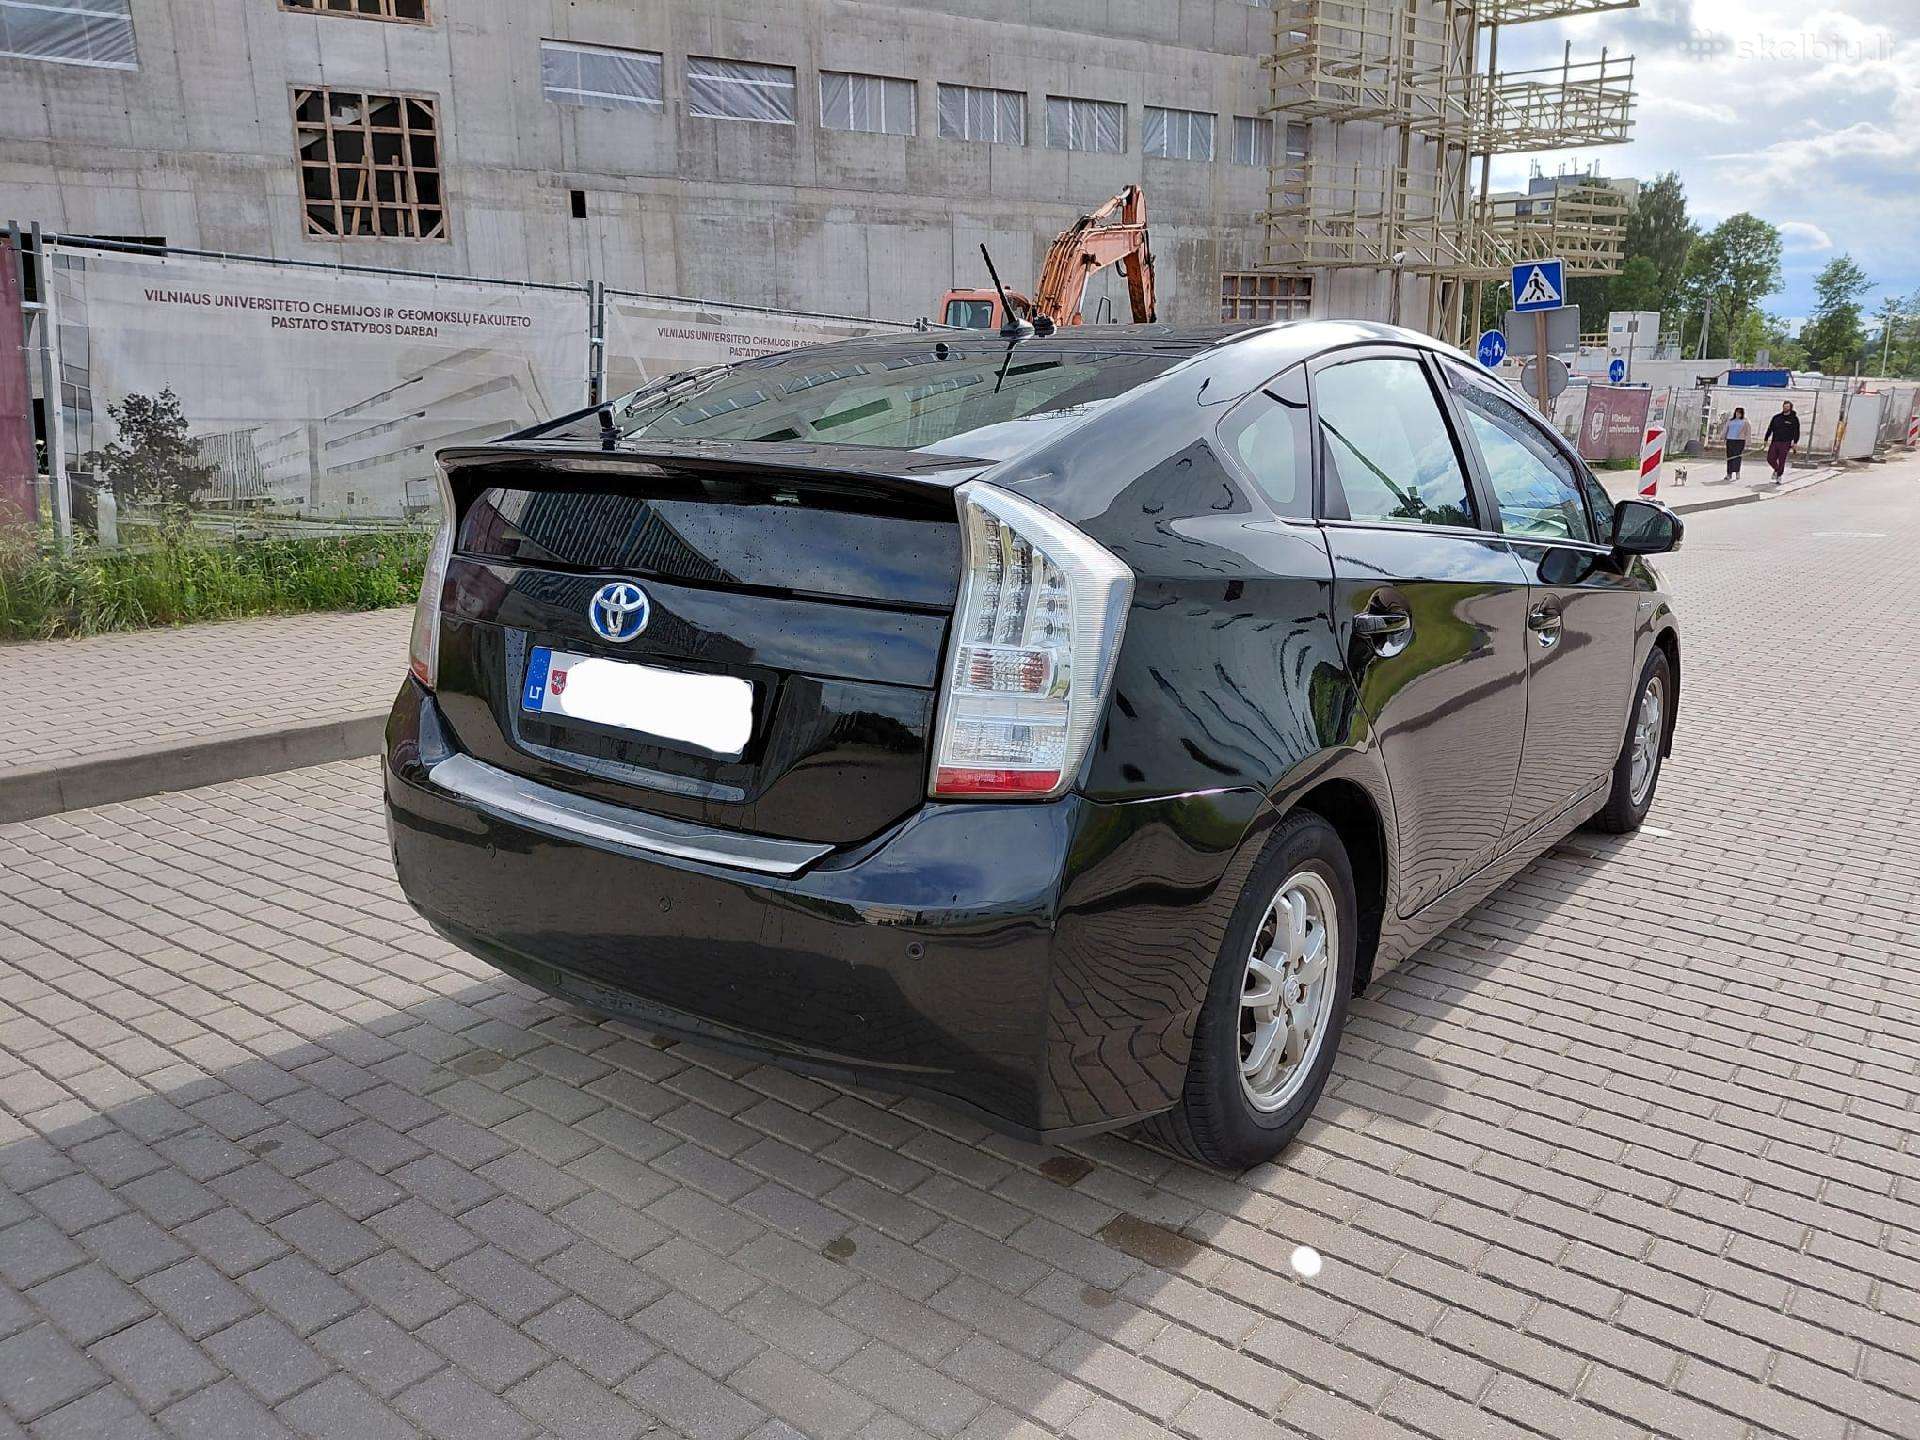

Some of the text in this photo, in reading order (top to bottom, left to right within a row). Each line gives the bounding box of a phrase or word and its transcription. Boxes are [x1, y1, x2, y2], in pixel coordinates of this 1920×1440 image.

[144, 289, 531, 328] VILNIAUS UNIVERSITETO CHEMIJOS IR GEOMOKSLŲ FAKULTETO
[271, 316, 438, 338] PASTATO STATYBOS DARBAI
[657, 327, 695, 340] VILNIAUS
[696, 329, 750, 345] UNIVERSITETO
[729, 347, 760, 358] PASTATO
[528, 685, 543, 700] LT
